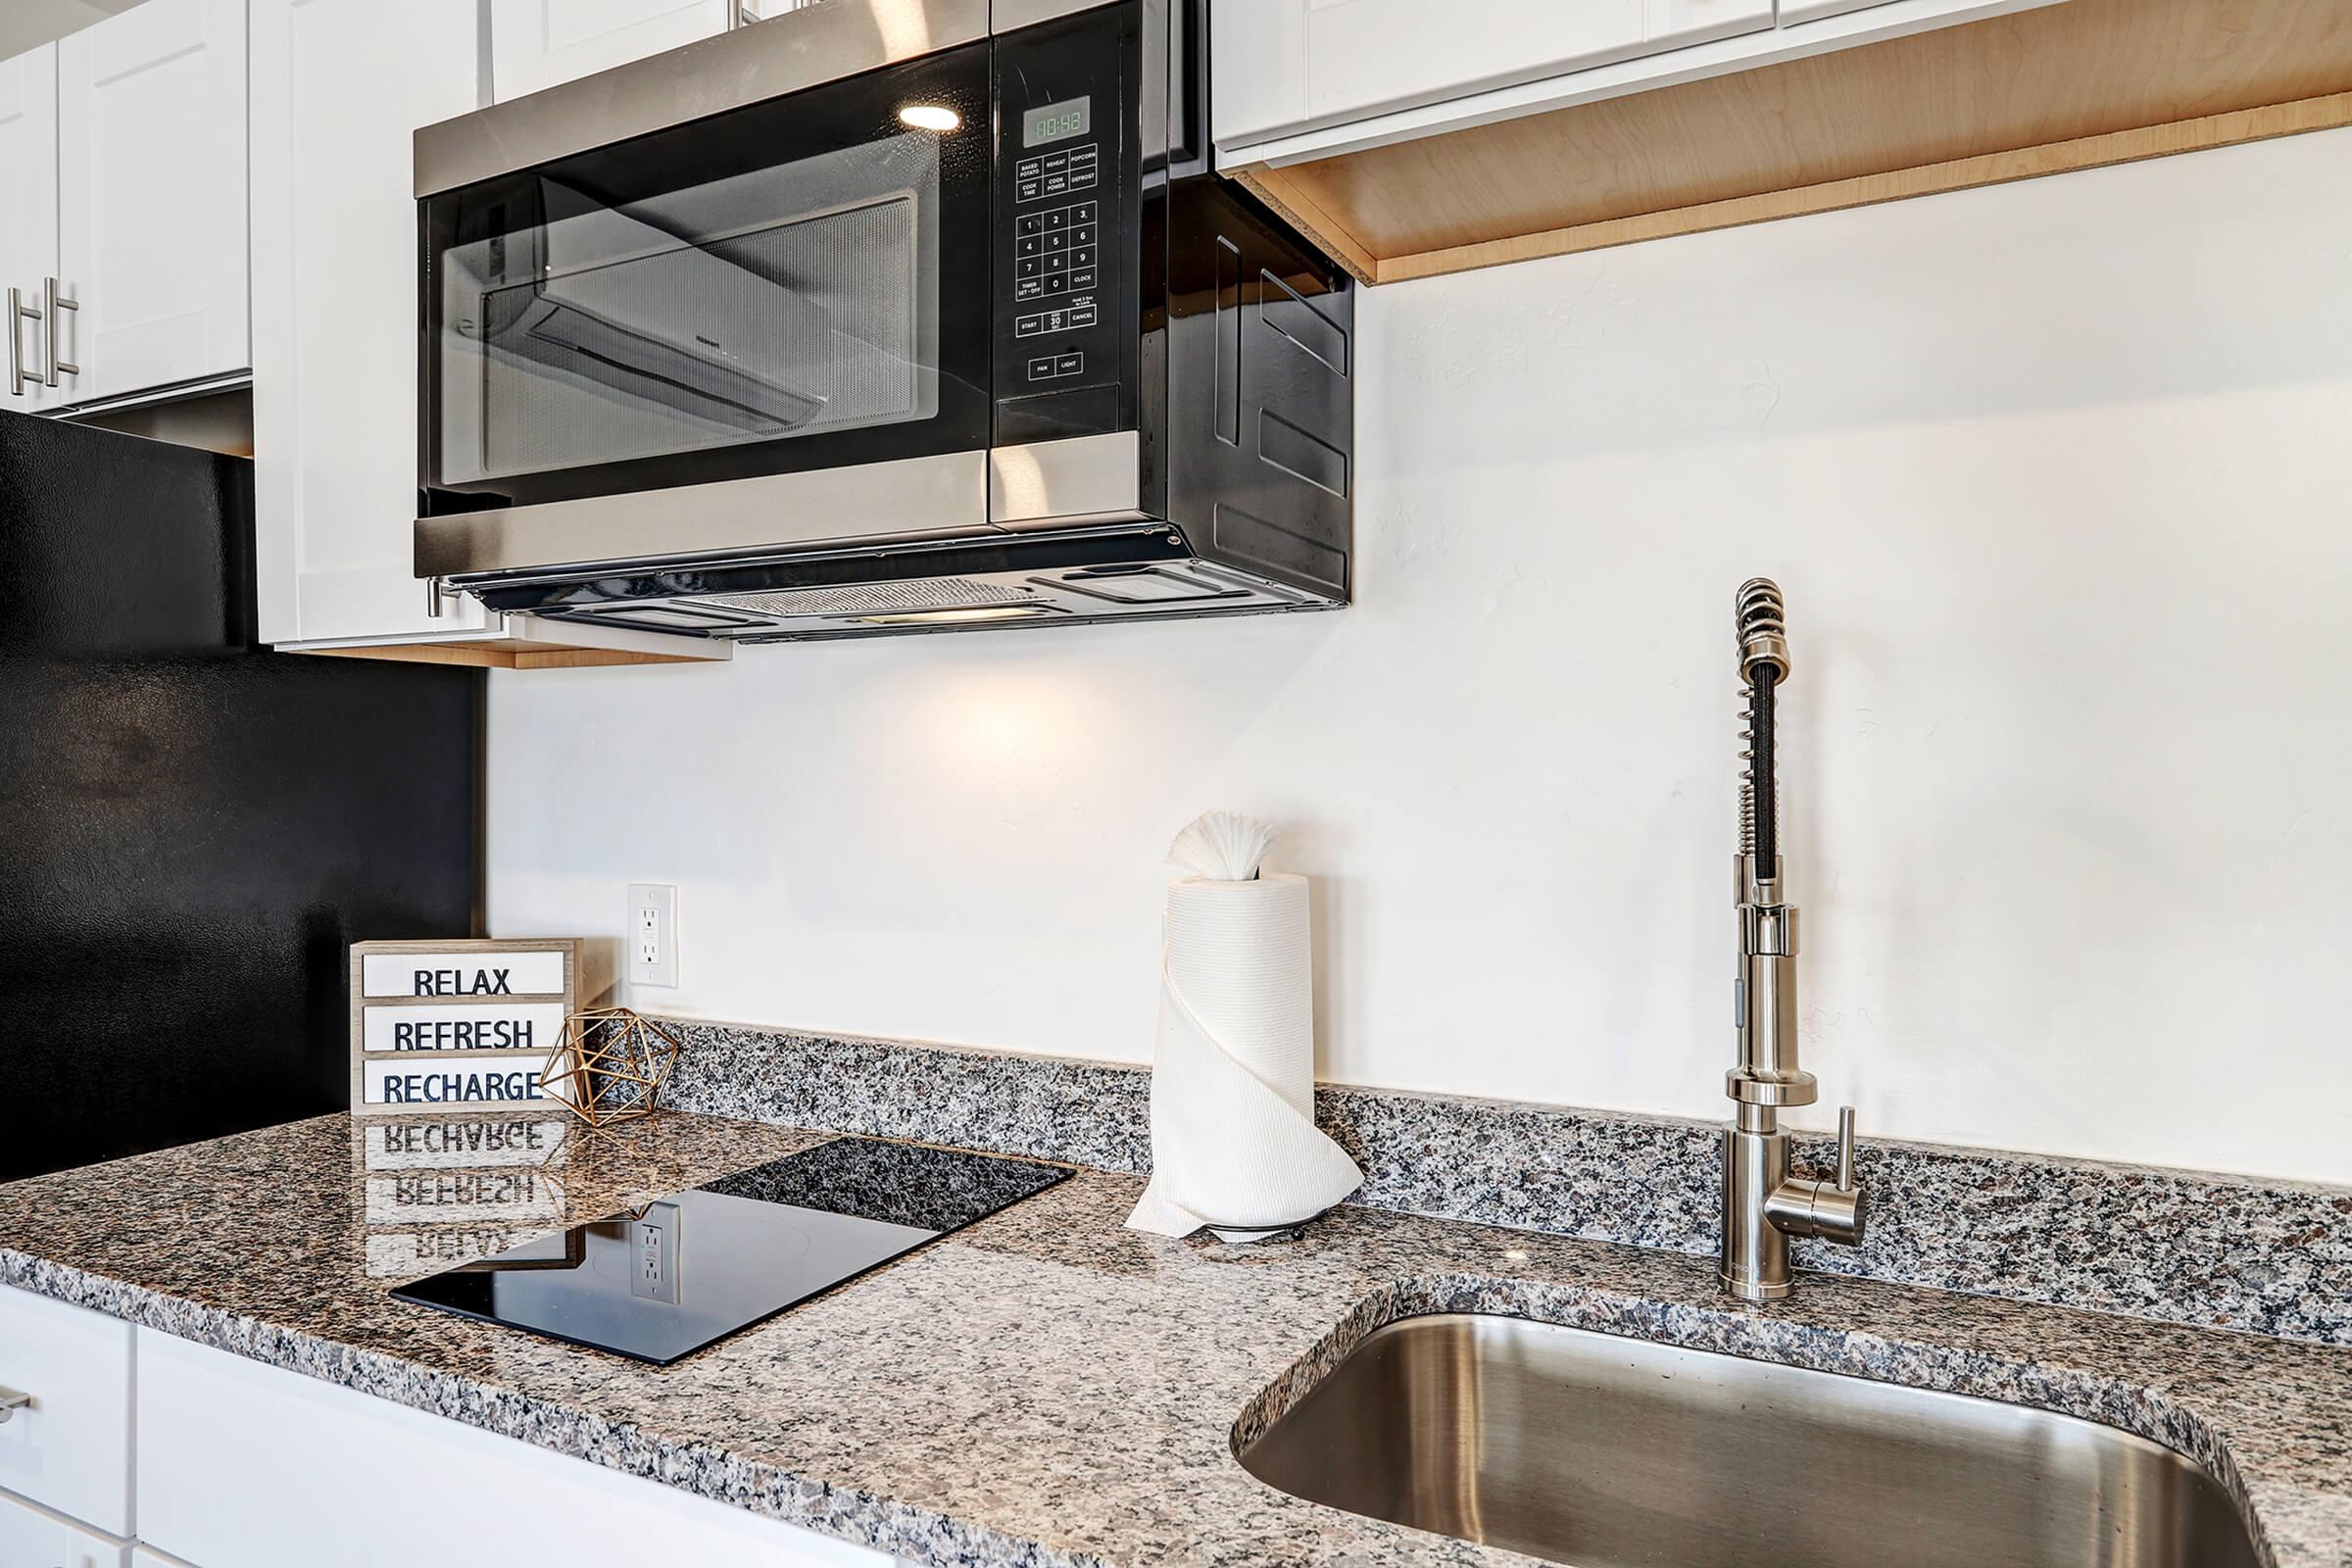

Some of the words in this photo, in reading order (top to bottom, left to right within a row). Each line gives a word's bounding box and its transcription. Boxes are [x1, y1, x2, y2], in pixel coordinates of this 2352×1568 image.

[1071, 152, 1096, 163] POPCORN
[1046, 159, 1066, 169] REHEAT
[1019, 169, 1040, 178] POTATO
[1071, 172, 1095, 182] DEFROST
[1048, 176, 1064, 185] COOK
[1022, 182, 1037, 191] COOK
[1047, 182, 1065, 191] POWER
[1080, 210, 1086, 219] 3
[1027, 220, 1032, 229] 1
[1053, 216, 1058, 224] 2
[1080, 231, 1086, 240] 6
[1026, 242, 1032, 251] 4
[1080, 253, 1086, 262] 9
[1026, 263, 1032, 271] 7
[1053, 258, 1058, 267] 8
[1053, 279, 1058, 288] 0
[1050, 317, 1061, 325] 30
[1072, 313, 1093, 321] CANCEL
[414, 968, 512, 997] RELAX
[394, 1020, 533, 1051] REFRESH
[384, 1072, 543, 1103] RECHARGE
